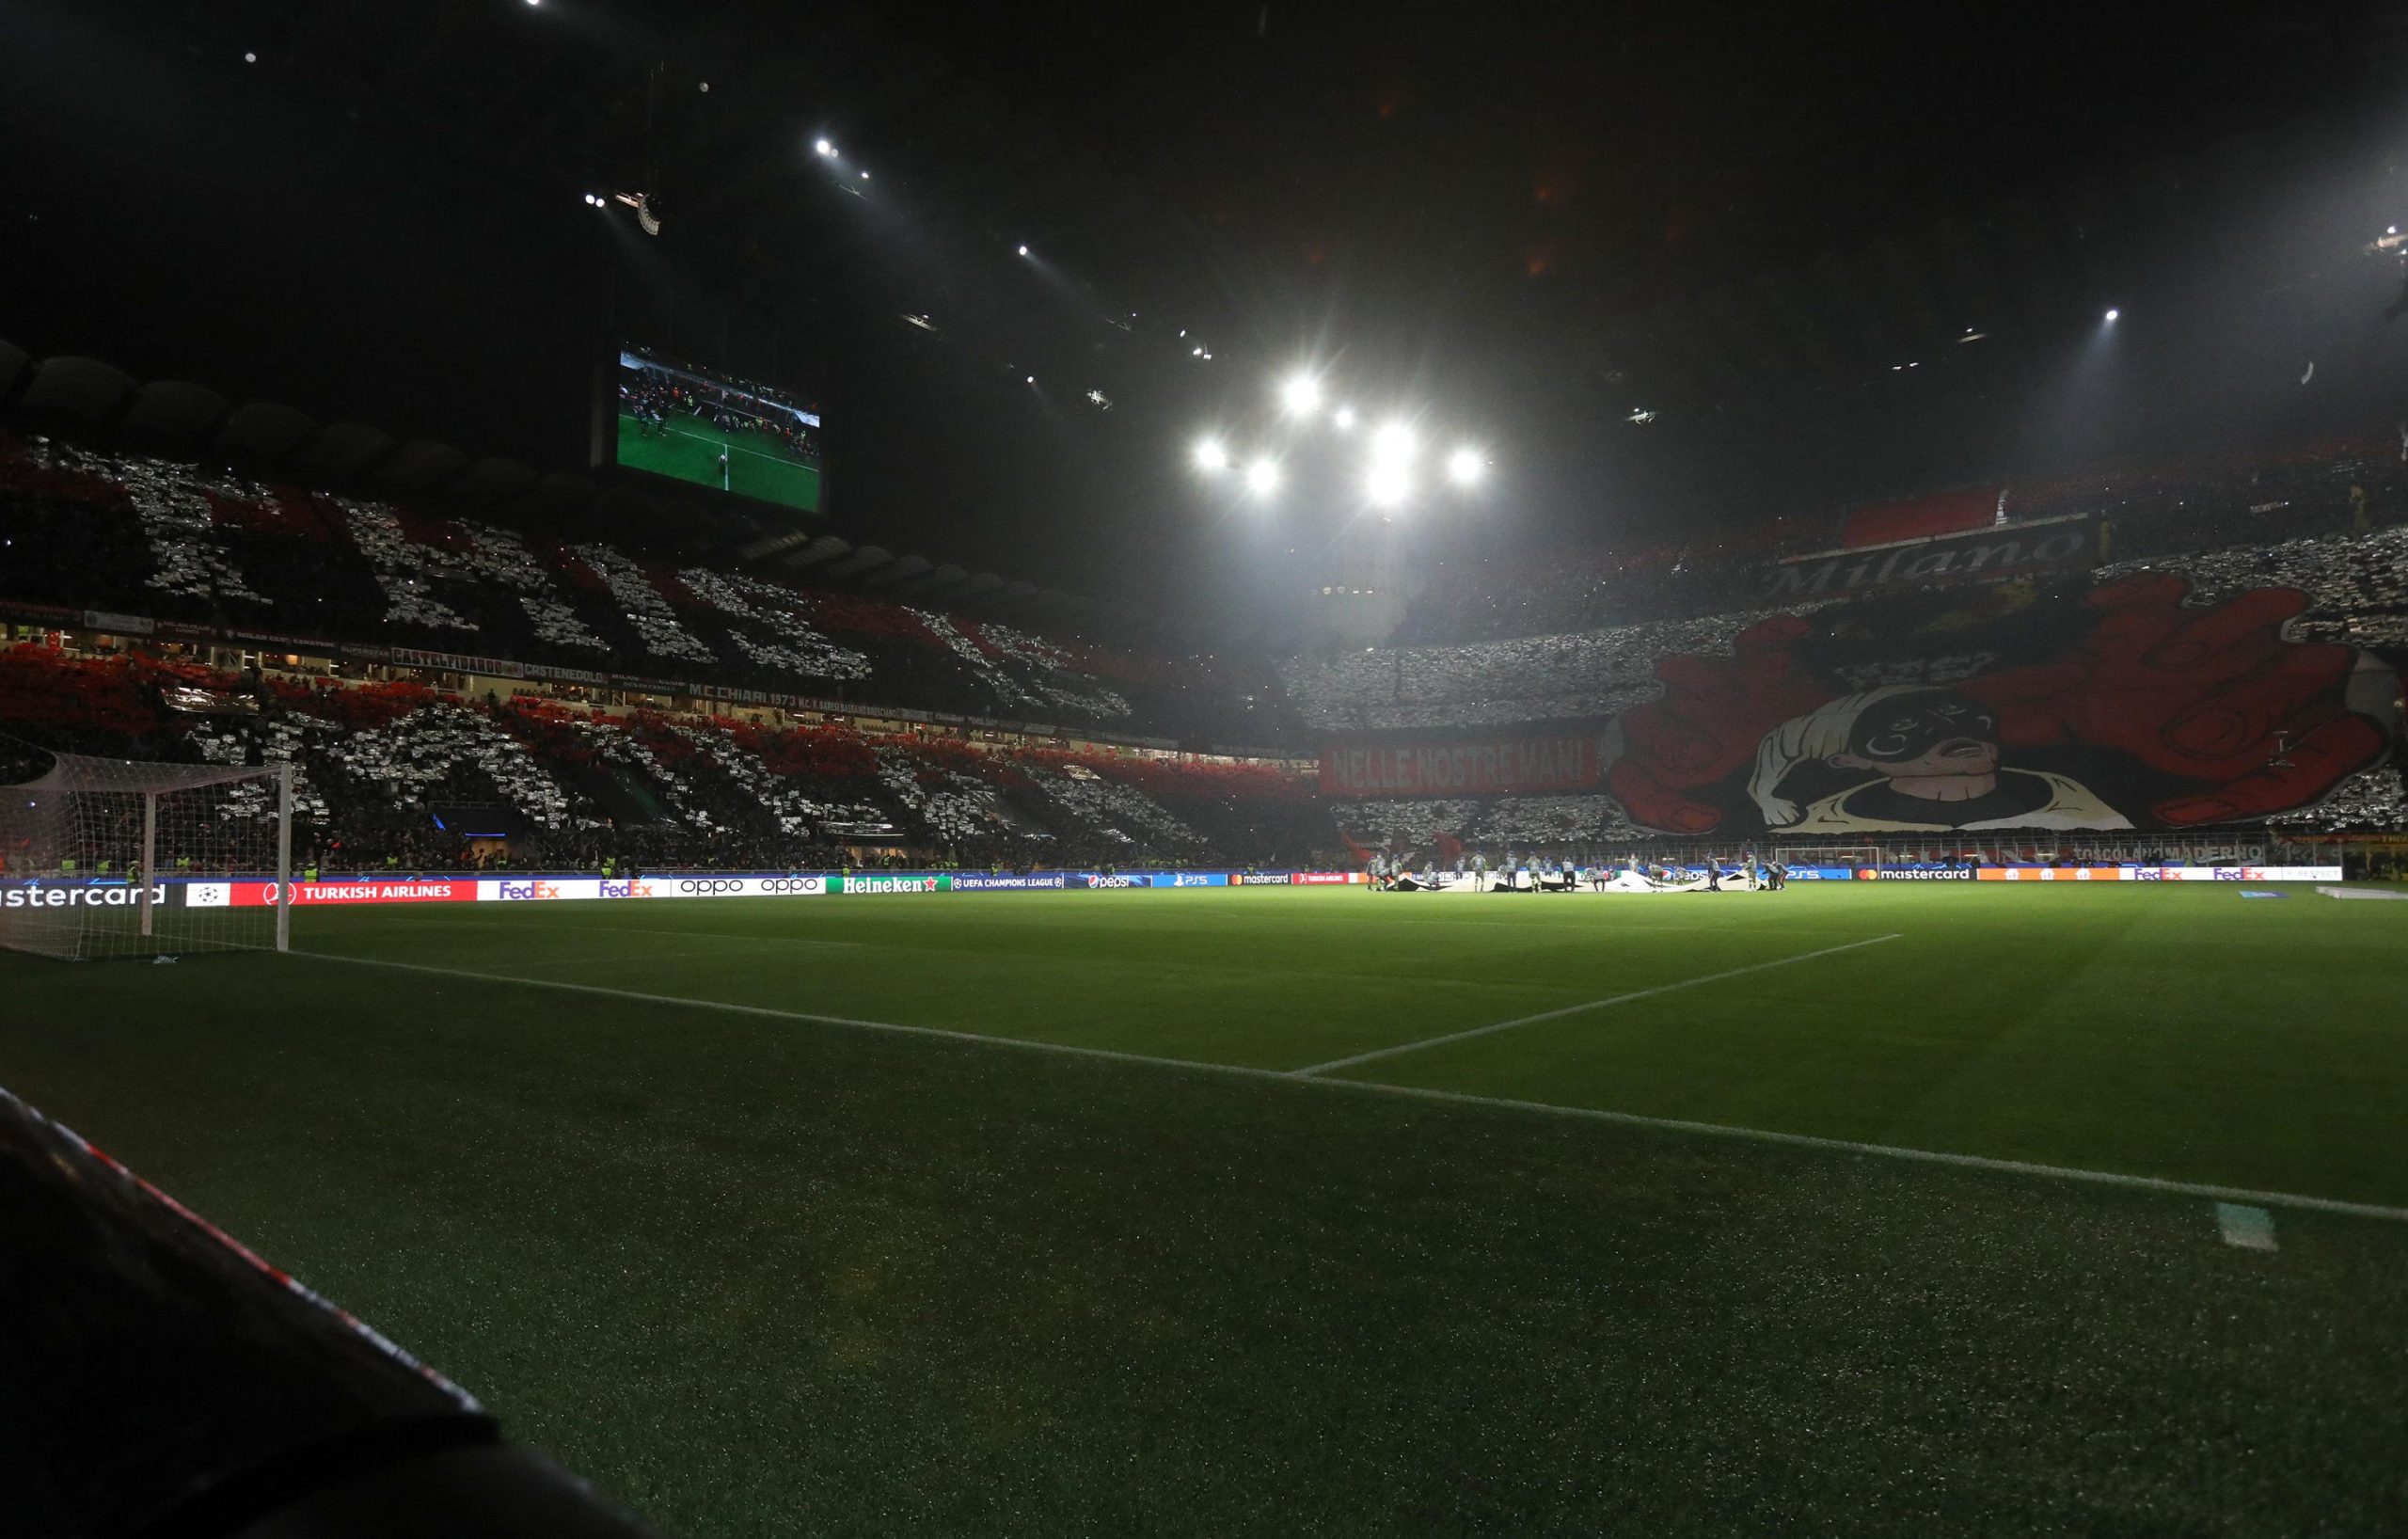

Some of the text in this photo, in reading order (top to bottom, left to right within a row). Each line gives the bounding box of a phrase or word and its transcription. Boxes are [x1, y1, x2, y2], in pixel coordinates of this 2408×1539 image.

[1760, 532, 2084, 598] Milano
[393, 648, 502, 674] CASTELFIDARDO
[524, 663, 603, 682] CASTENEDOLO
[770, 693, 796, 706] 1973
[1333, 749, 1414, 788] NELLE
[1417, 744, 1515, 786] NOSTRE
[1185, 875, 1208, 884] PS5
[1244, 873, 1289, 884] mastercard
[1880, 867, 1970, 880] mastercard
[2134, 867, 2183, 881] FedEx
[2213, 867, 2265, 881] FedEx
[599, 880, 653, 897] FedEx
[681, 880, 743, 896] oppo
[761, 879, 818, 894] oppo
[843, 877, 922, 893] Heineken
[963, 877, 1054, 888] UEFA CHAMPIONS LEAGUE
[1100, 875, 1130, 888] pepsi
[0, 883, 166, 907] stercard
[304, 885, 452, 899] TURKISH AIRLINES
[499, 881, 560, 899] FedEx
